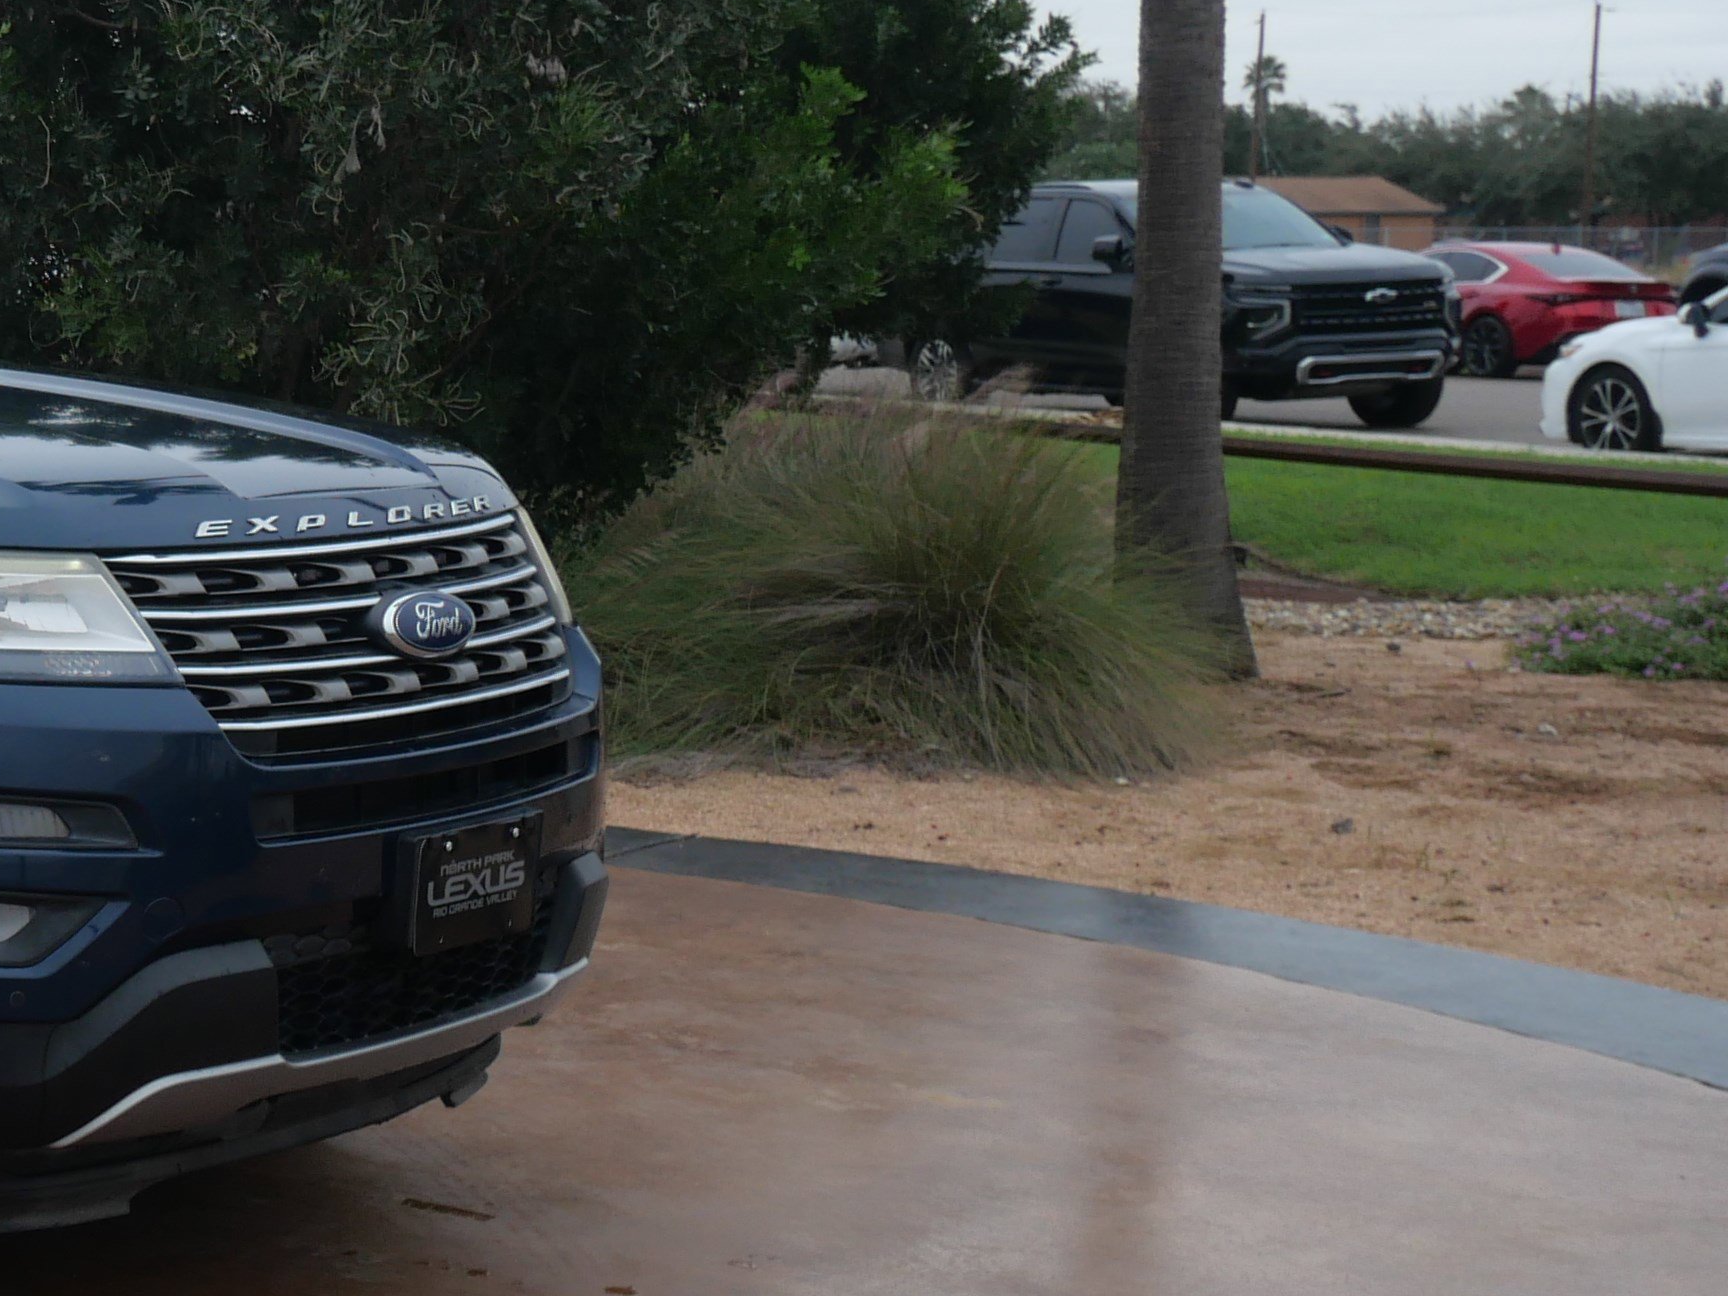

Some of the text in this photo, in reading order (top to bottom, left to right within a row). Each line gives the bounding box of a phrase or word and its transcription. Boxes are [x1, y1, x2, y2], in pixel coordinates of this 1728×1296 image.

[196, 494, 491, 538] EXPLORER
[414, 601, 463, 639] Ford
[440, 849, 515, 877] NORTH PARK
[427, 860, 525, 907] LEXUS
[433, 889, 518, 918] RIO GRANDE VALLEY
